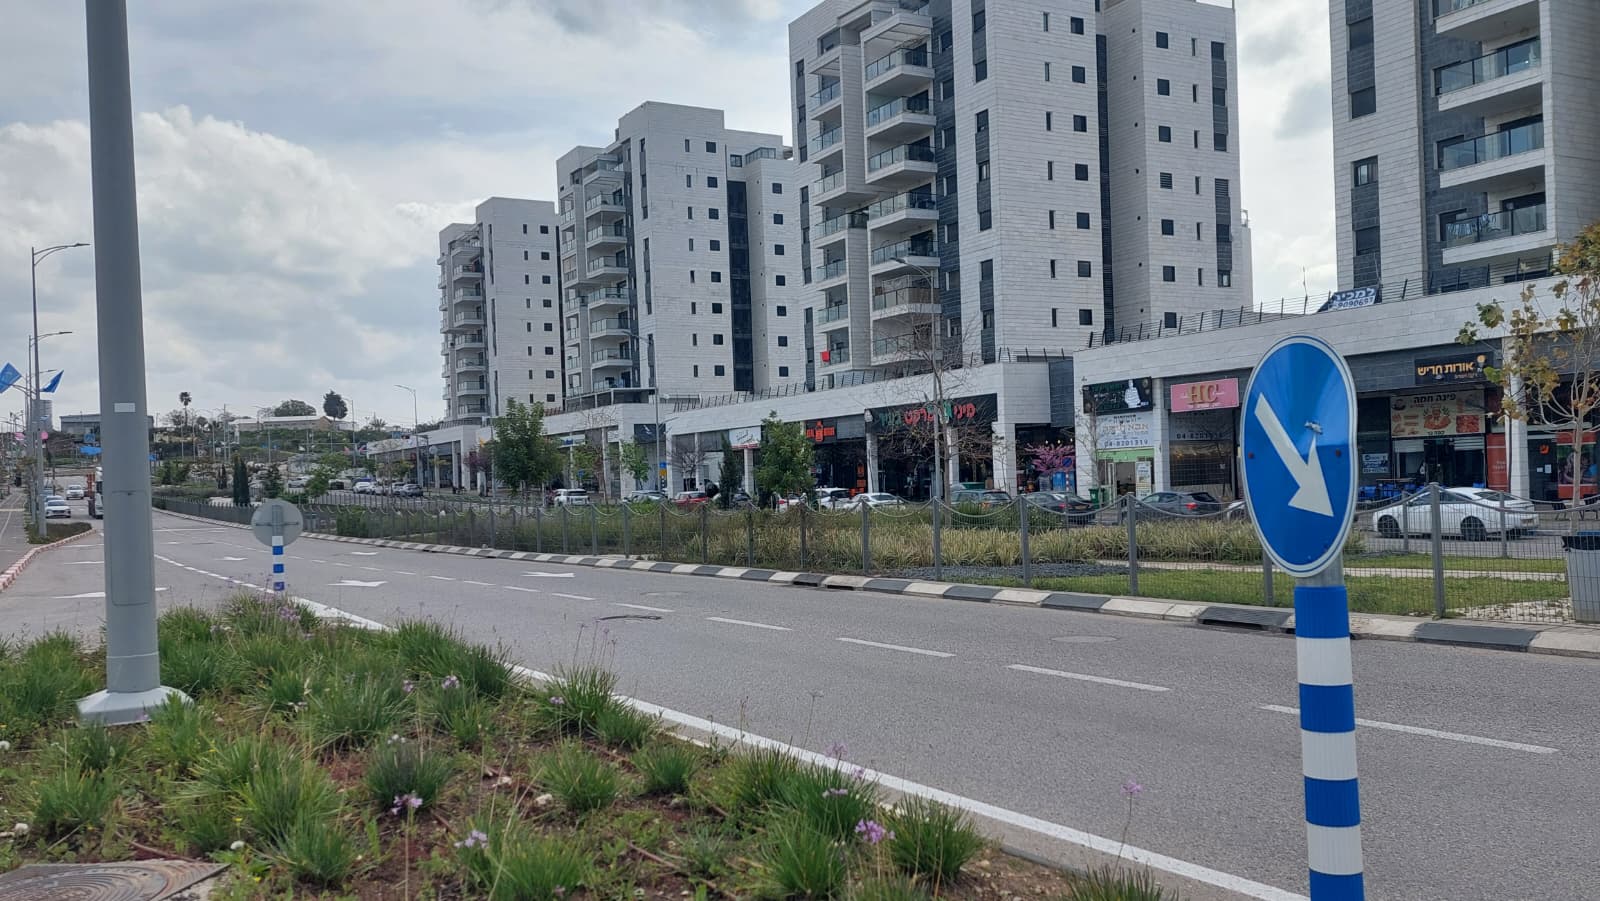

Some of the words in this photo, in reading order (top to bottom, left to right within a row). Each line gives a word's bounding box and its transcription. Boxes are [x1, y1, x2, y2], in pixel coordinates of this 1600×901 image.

[1334, 287, 1375, 302] למכיר
[1417, 364, 1443, 376] חריש
[1444, 361, 1474, 374] אורות
[1413, 395, 1434, 404] חמה
[1435, 392, 1456, 402] פינה
[953, 402, 976, 419] מיני
